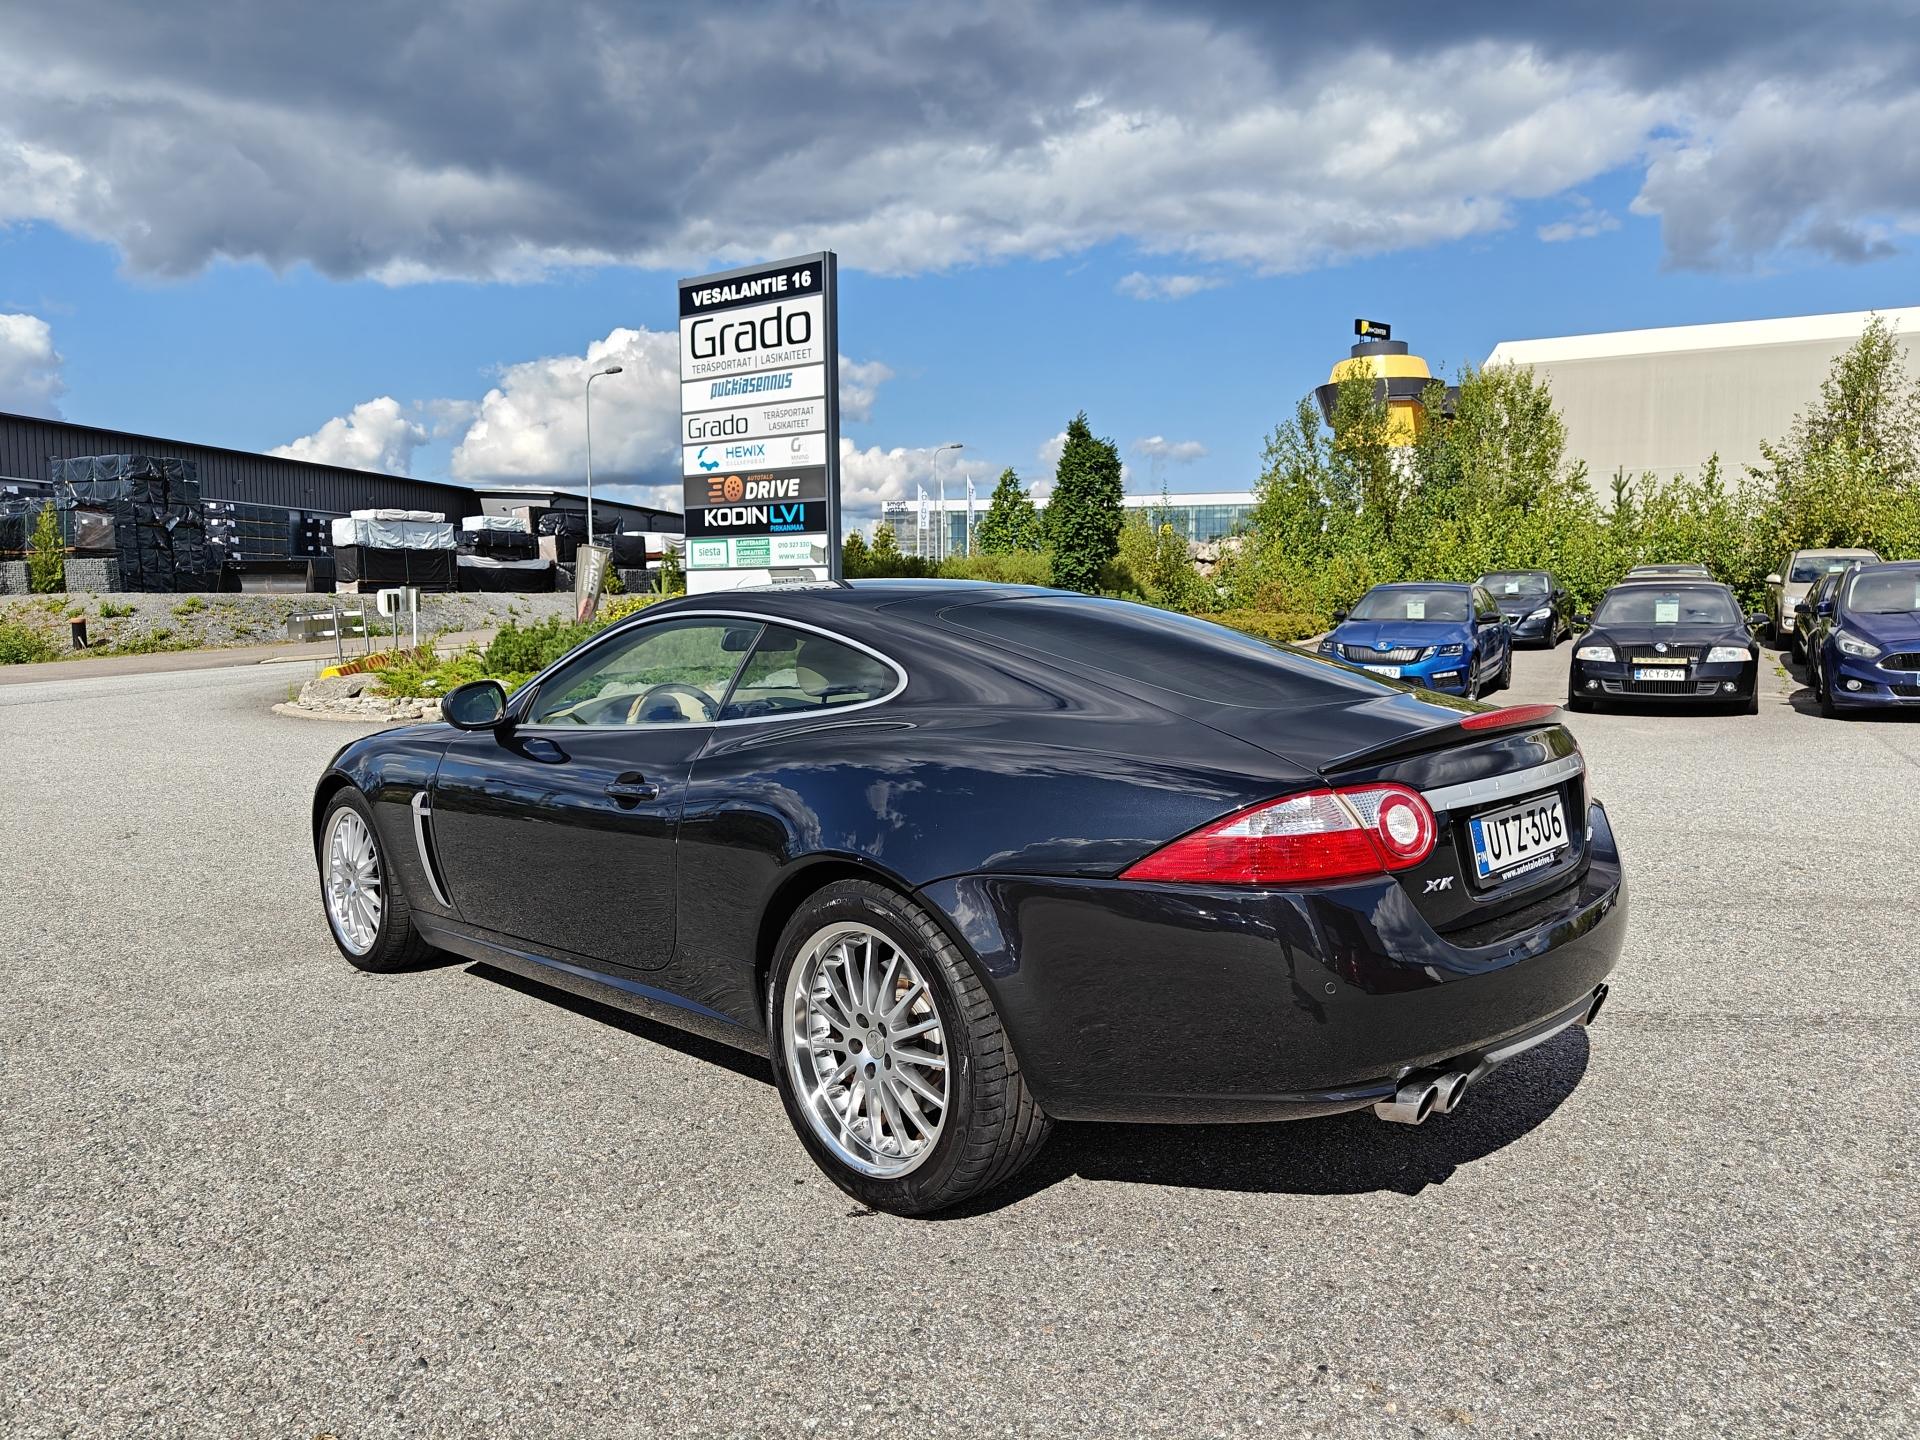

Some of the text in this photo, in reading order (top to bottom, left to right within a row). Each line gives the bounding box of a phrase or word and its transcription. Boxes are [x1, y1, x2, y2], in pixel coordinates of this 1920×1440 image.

[692, 270, 812, 307] VESALANTIE 16
[690, 306, 812, 360] Grado
[692, 348, 812, 375] TERÄSPORTAAT LASIKAITEET
[710, 372, 793, 400] putkiasennus
[763, 406, 815, 421] TERÄSPORTAAT
[688, 413, 749, 440] Grado
[768, 418, 809, 431] LASIKAITEET
[725, 443, 765, 460] HEWIX
[747, 473, 774, 482] AUTOTALO
[745, 478, 800, 500] DRIVE
[770, 523, 805, 532] PIRKANMAA
[698, 547, 721, 557] siesta
[1642, 669, 1682, 679] XCY-874
[1486, 802, 1563, 861] UTZ-306
[1477, 851, 1489, 865] FIN
[1501, 852, 1556, 881] www.autotalodrive.fi
[1422, 876, 1455, 894] XK
